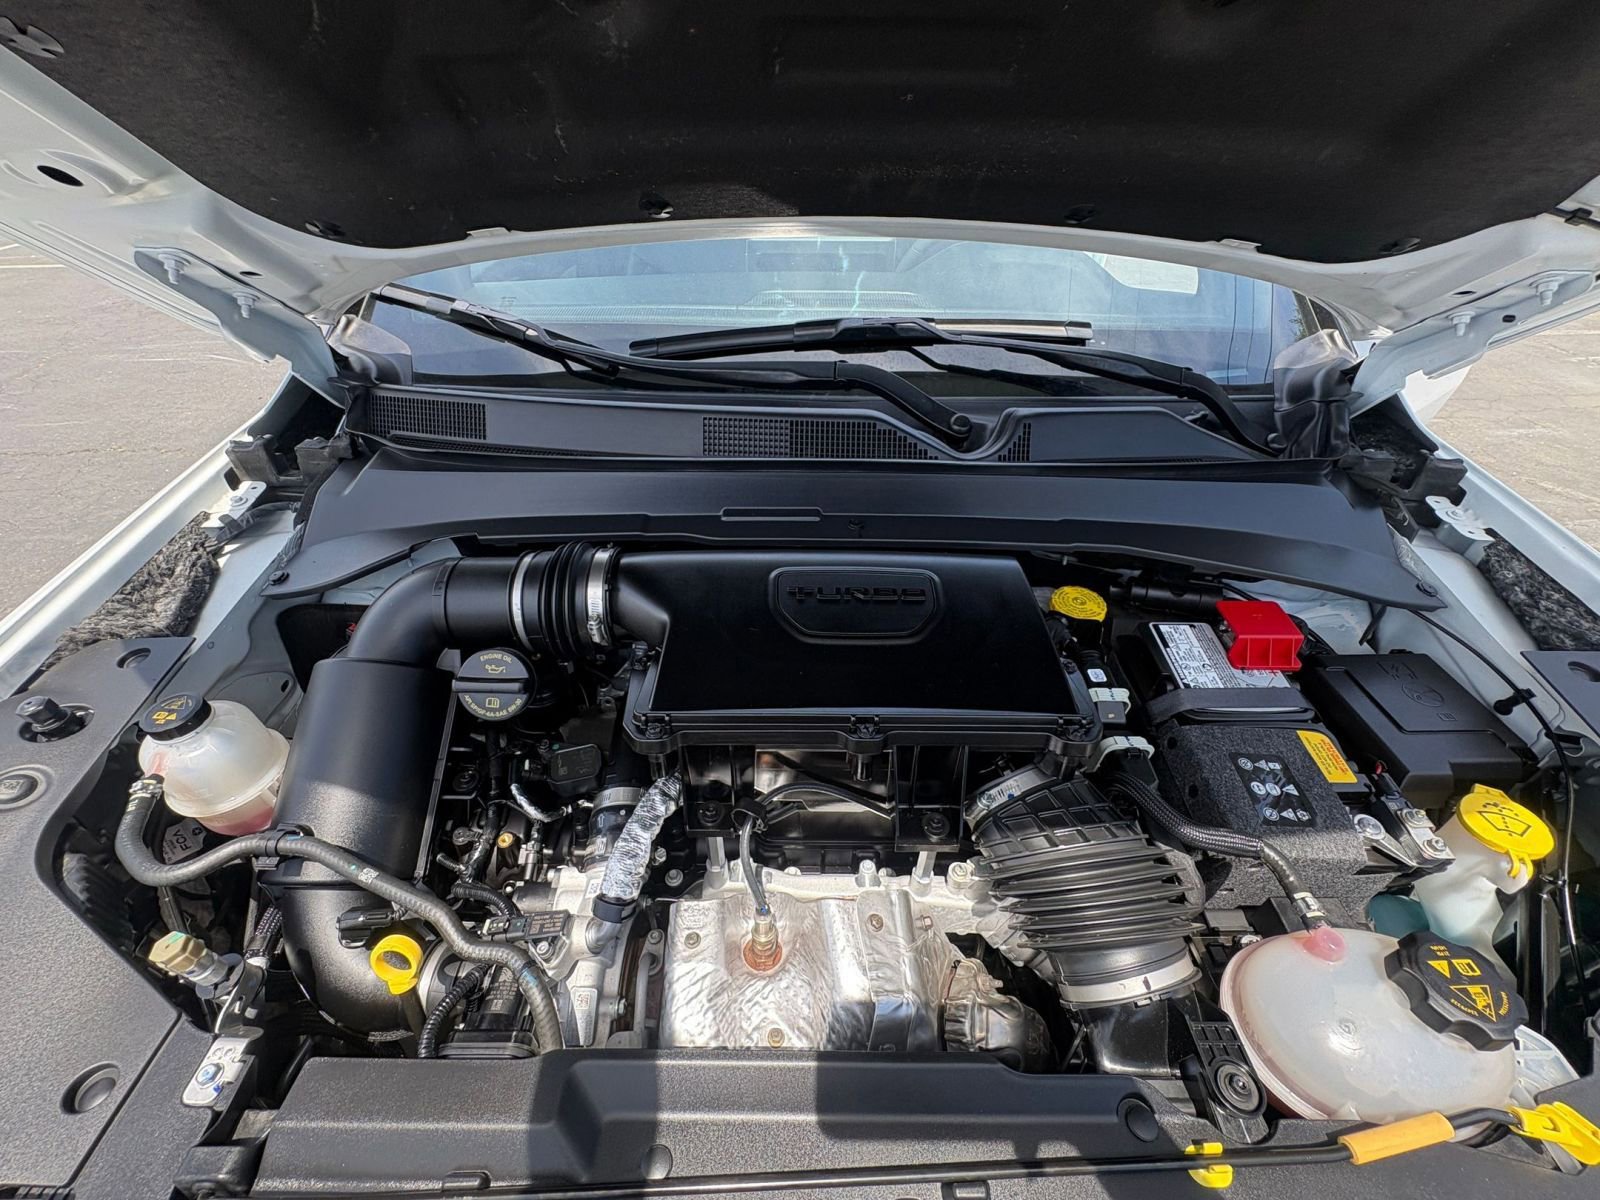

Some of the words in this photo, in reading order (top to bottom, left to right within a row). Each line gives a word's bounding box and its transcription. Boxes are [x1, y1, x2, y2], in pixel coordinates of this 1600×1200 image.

[786, 585, 926, 601] TURBO
[480, 653, 503, 662] ENGINE
[503, 655, 513, 664] OIL
[172, 827, 192, 851] FCA
